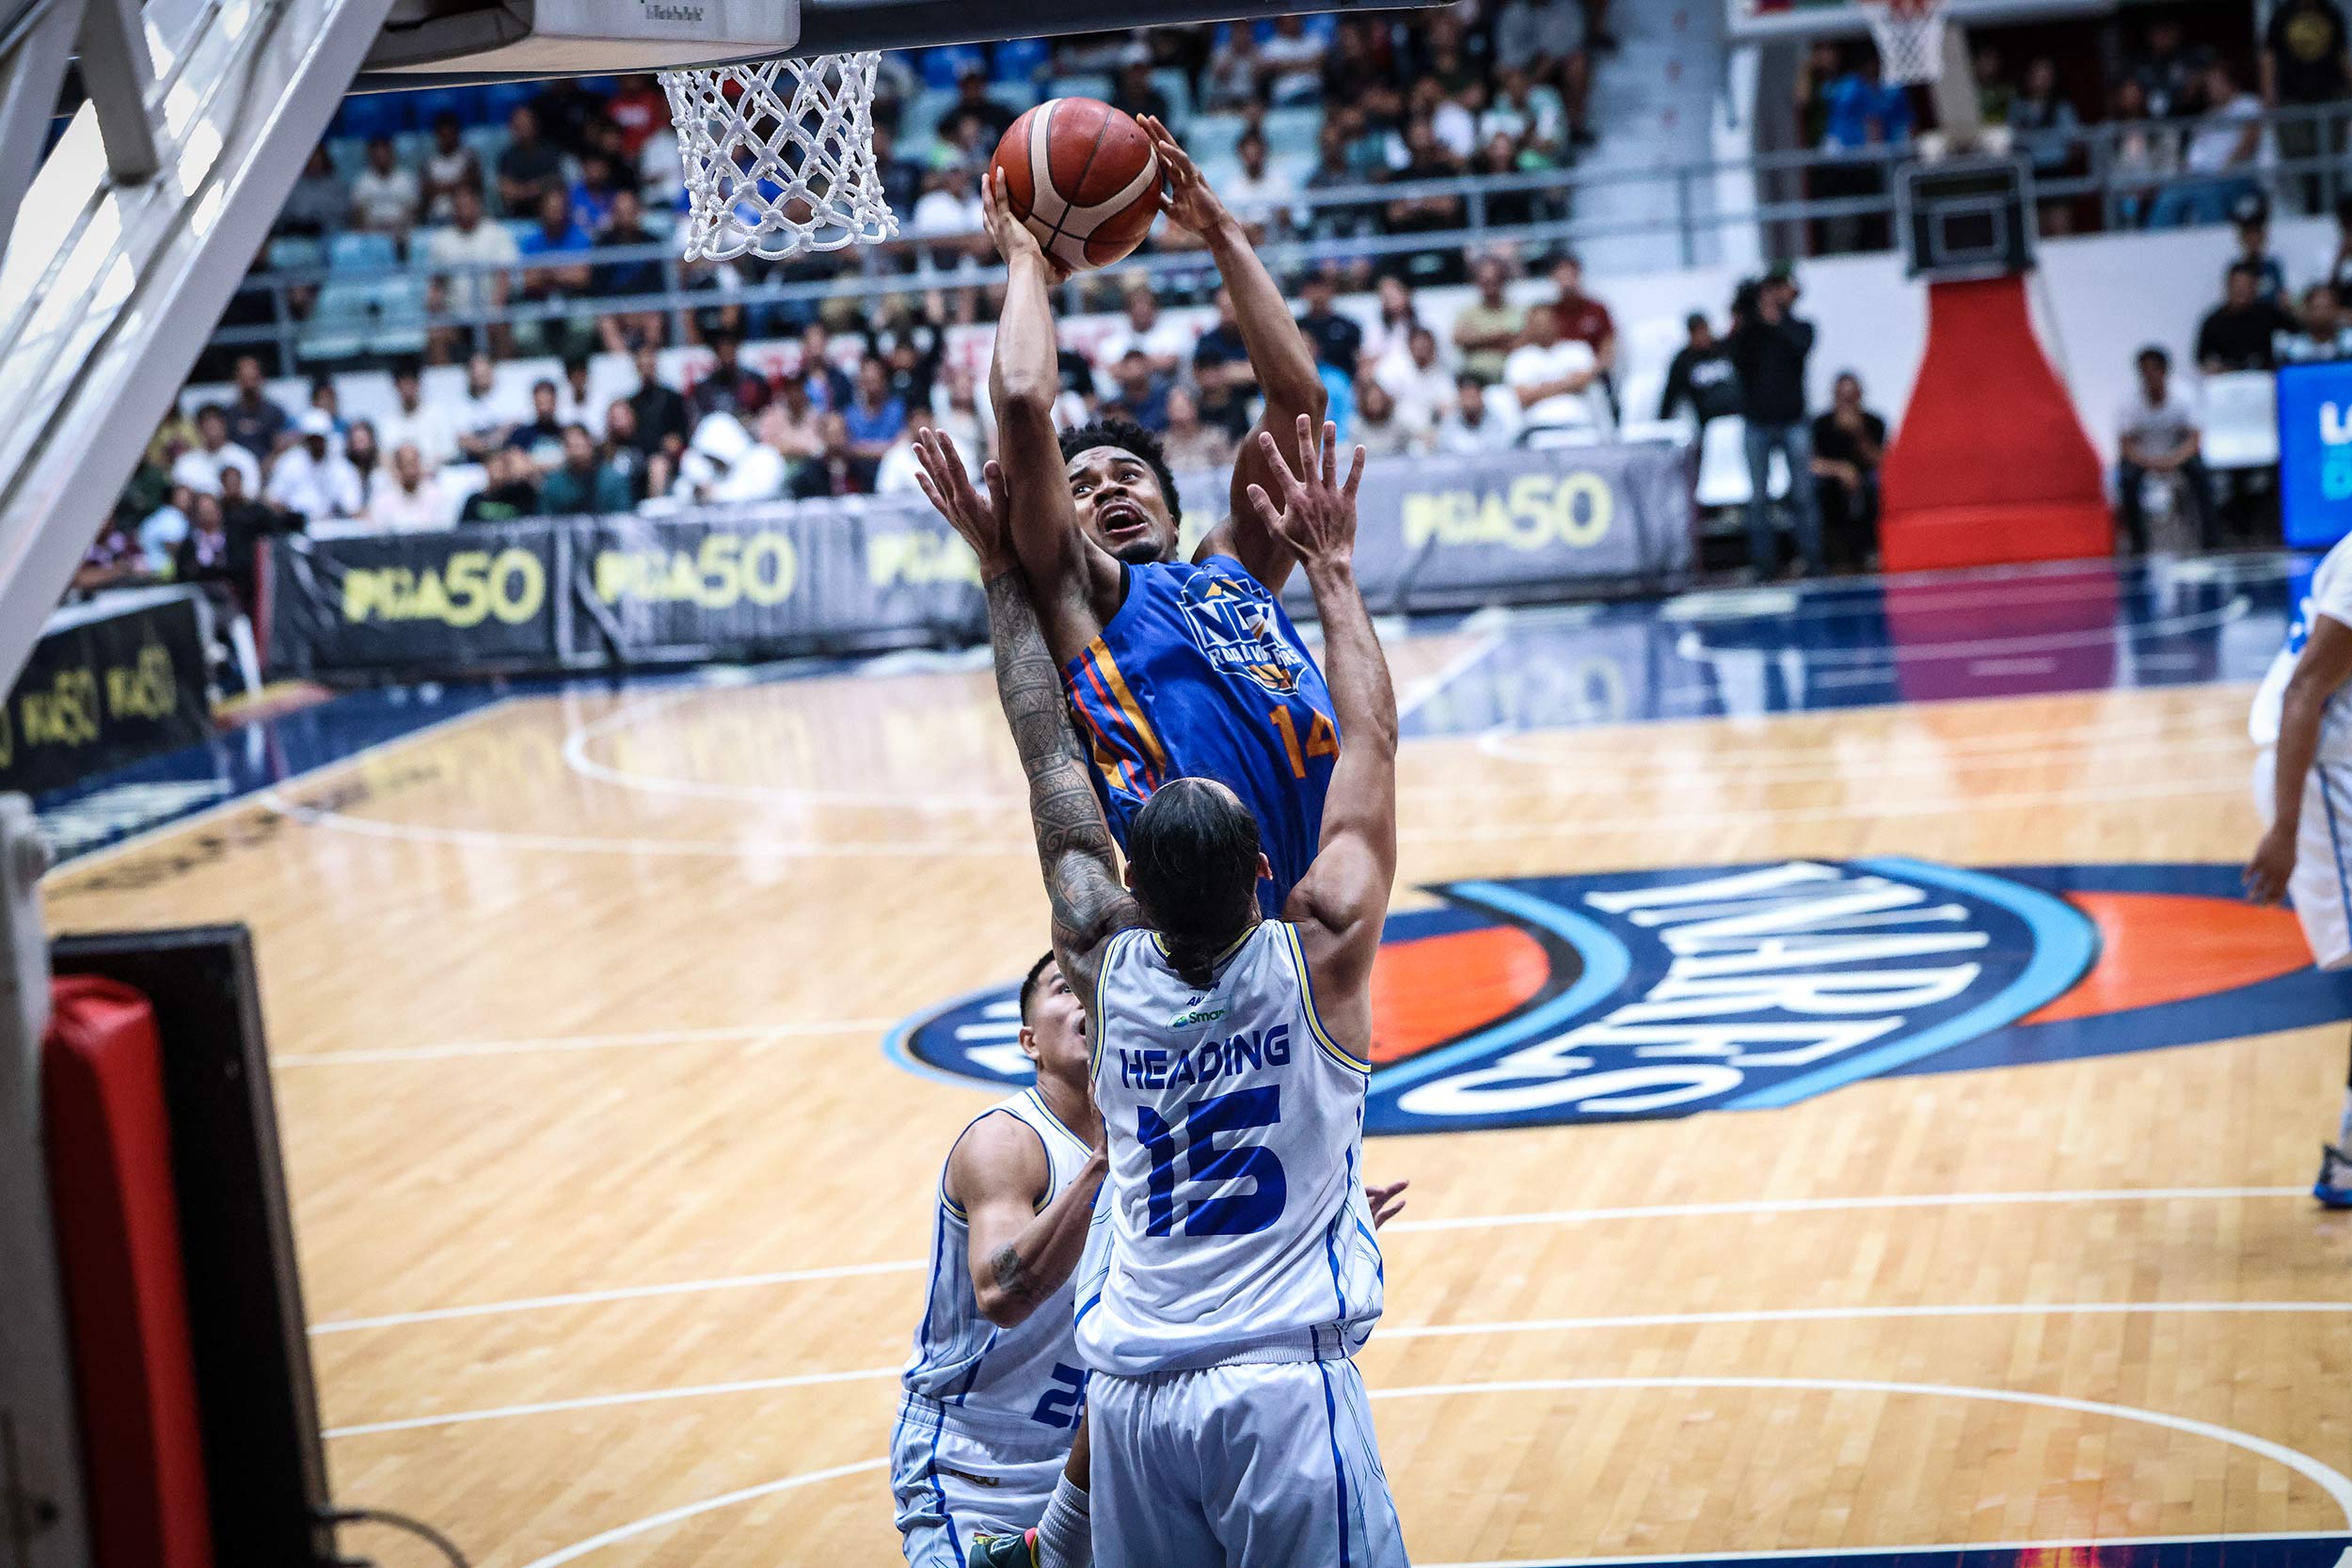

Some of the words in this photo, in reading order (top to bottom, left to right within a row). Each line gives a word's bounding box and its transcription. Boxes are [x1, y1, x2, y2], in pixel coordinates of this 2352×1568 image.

[1269, 704, 1342, 780] 14
[1119, 1023, 1291, 1090] HEADING
[1136, 1084, 1287, 1238] 15
